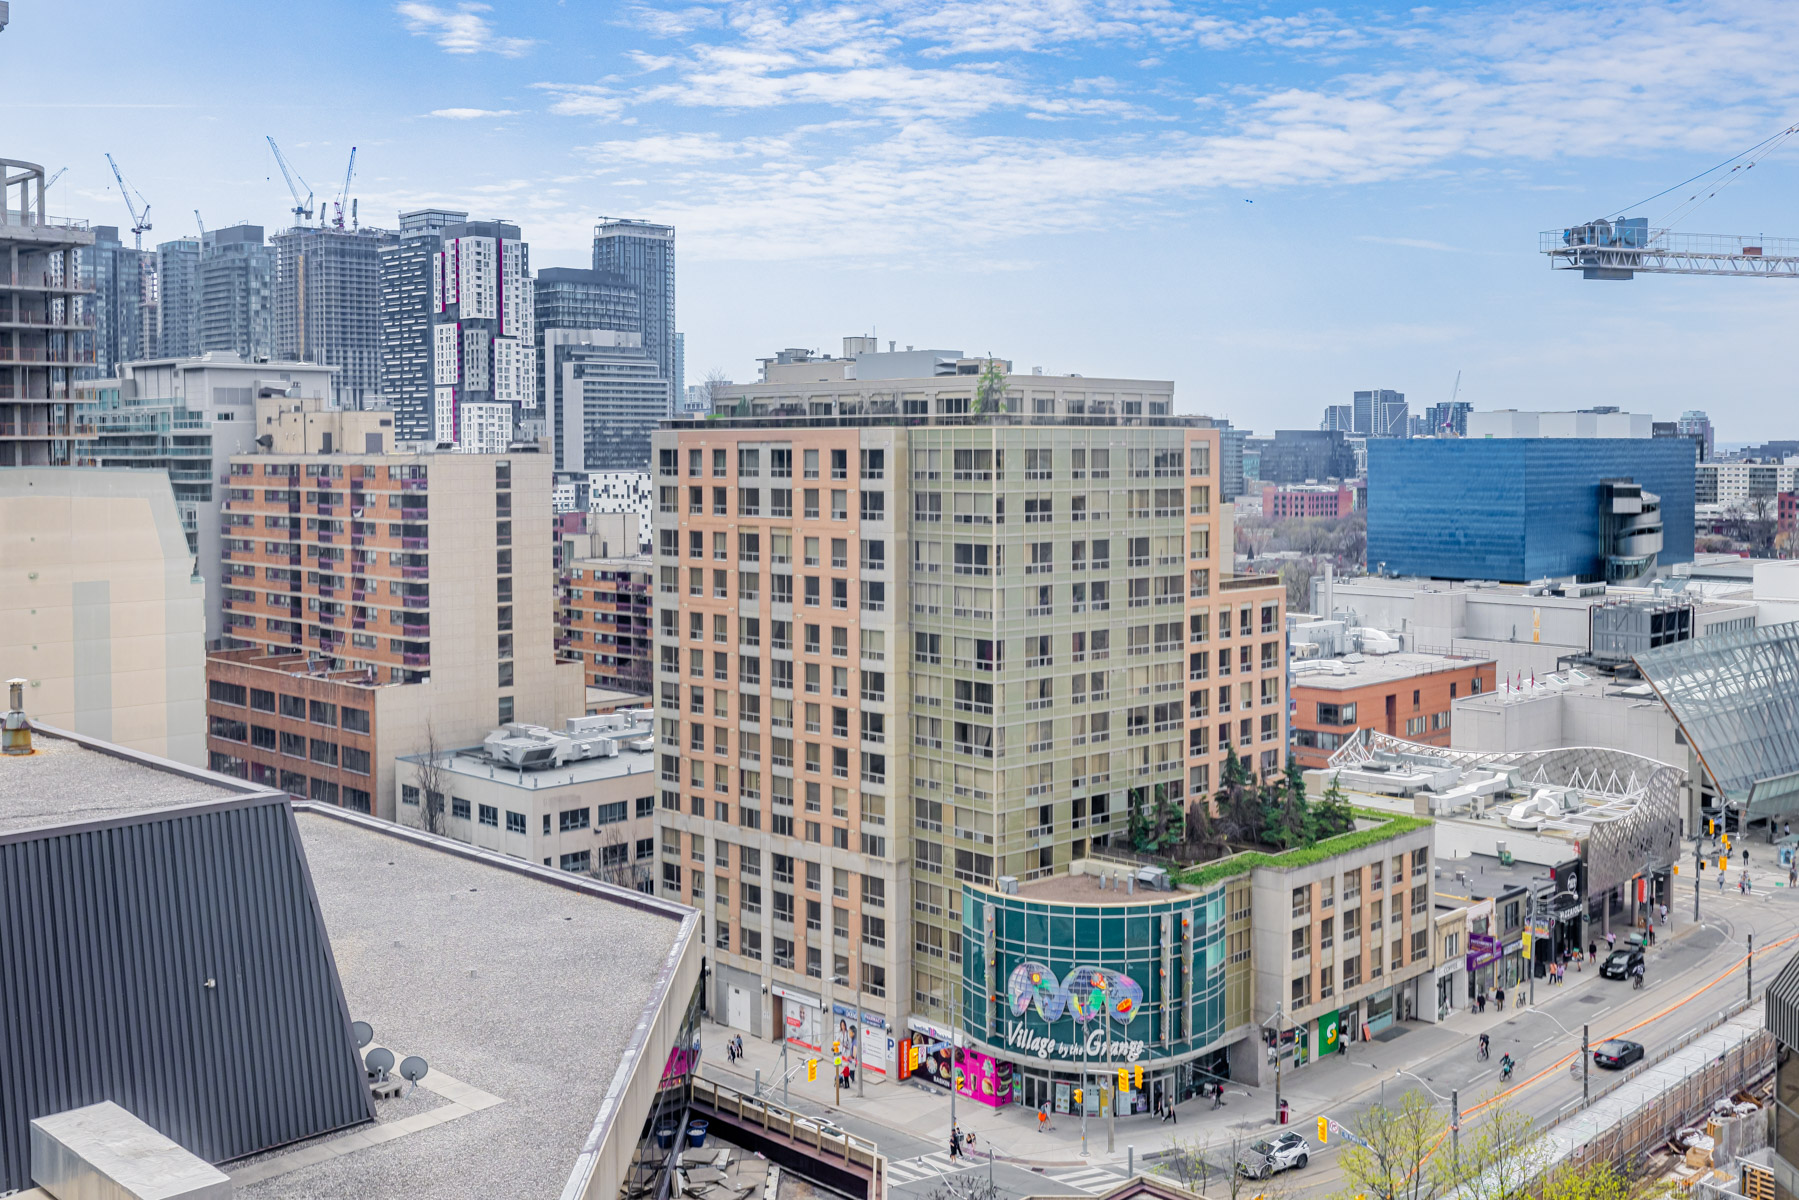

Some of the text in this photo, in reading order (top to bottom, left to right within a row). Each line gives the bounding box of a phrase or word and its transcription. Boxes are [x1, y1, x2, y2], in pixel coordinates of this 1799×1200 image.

[887, 1038, 895, 1051] P
[1007, 1019, 1145, 1063] Village by the Grange
